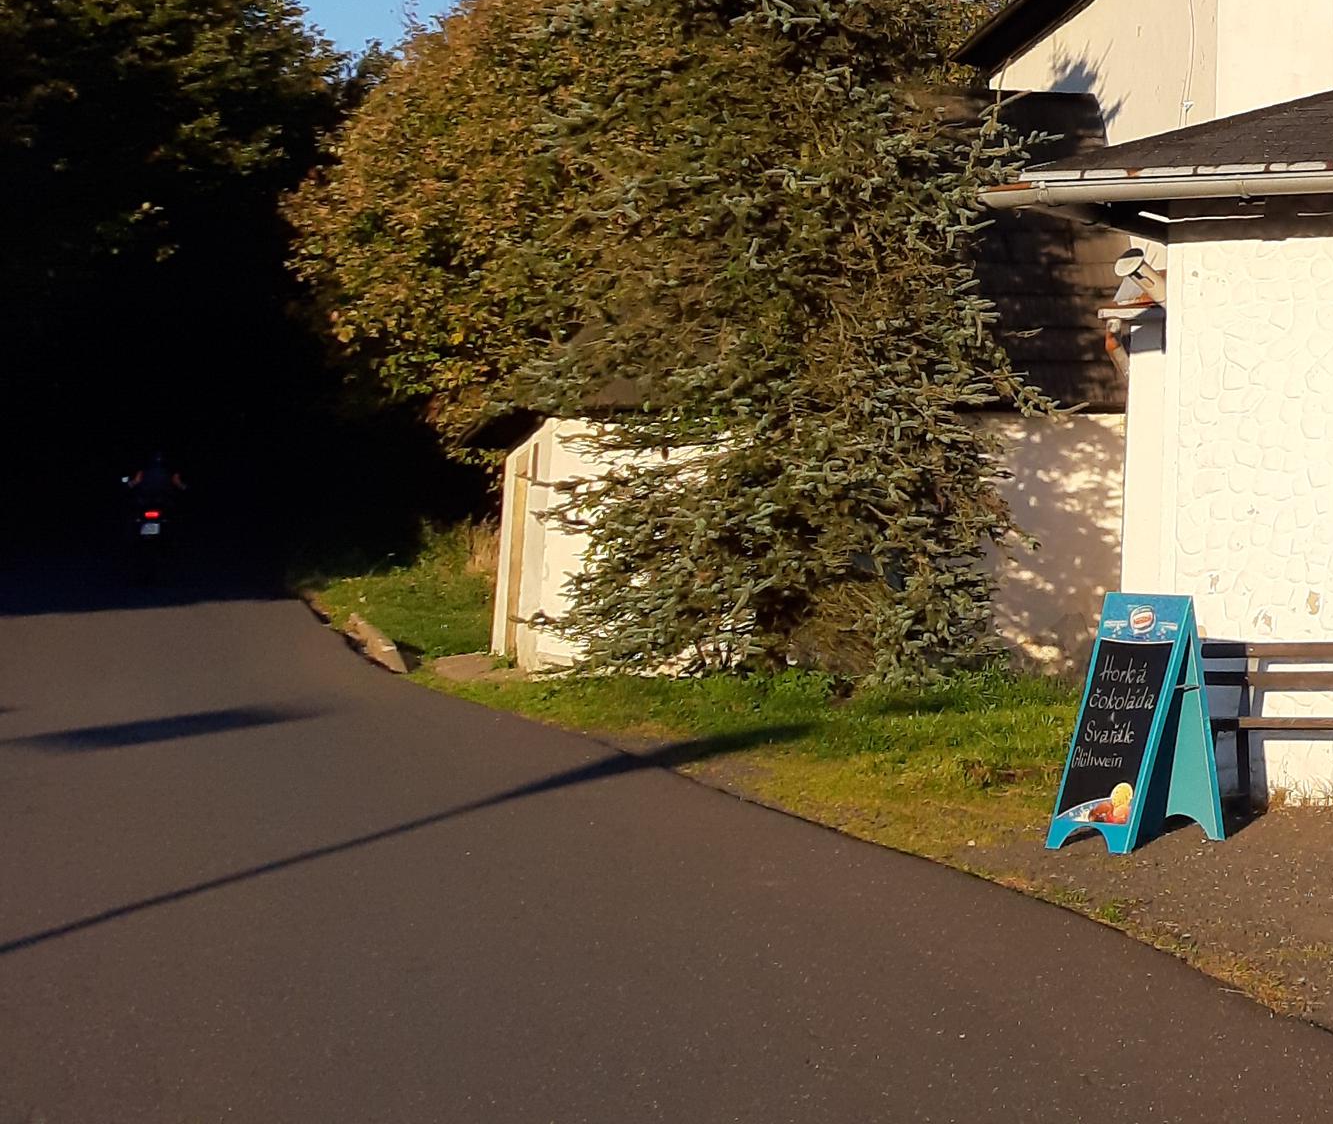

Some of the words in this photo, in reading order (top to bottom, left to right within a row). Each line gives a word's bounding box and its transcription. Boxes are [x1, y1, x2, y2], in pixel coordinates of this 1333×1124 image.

[1099, 654, 1148, 684] Horká
[1088, 686, 1155, 711] čokoláda
[1084, 719, 1135, 744] Svařák
[1071, 746, 1123, 768] Glühwein
